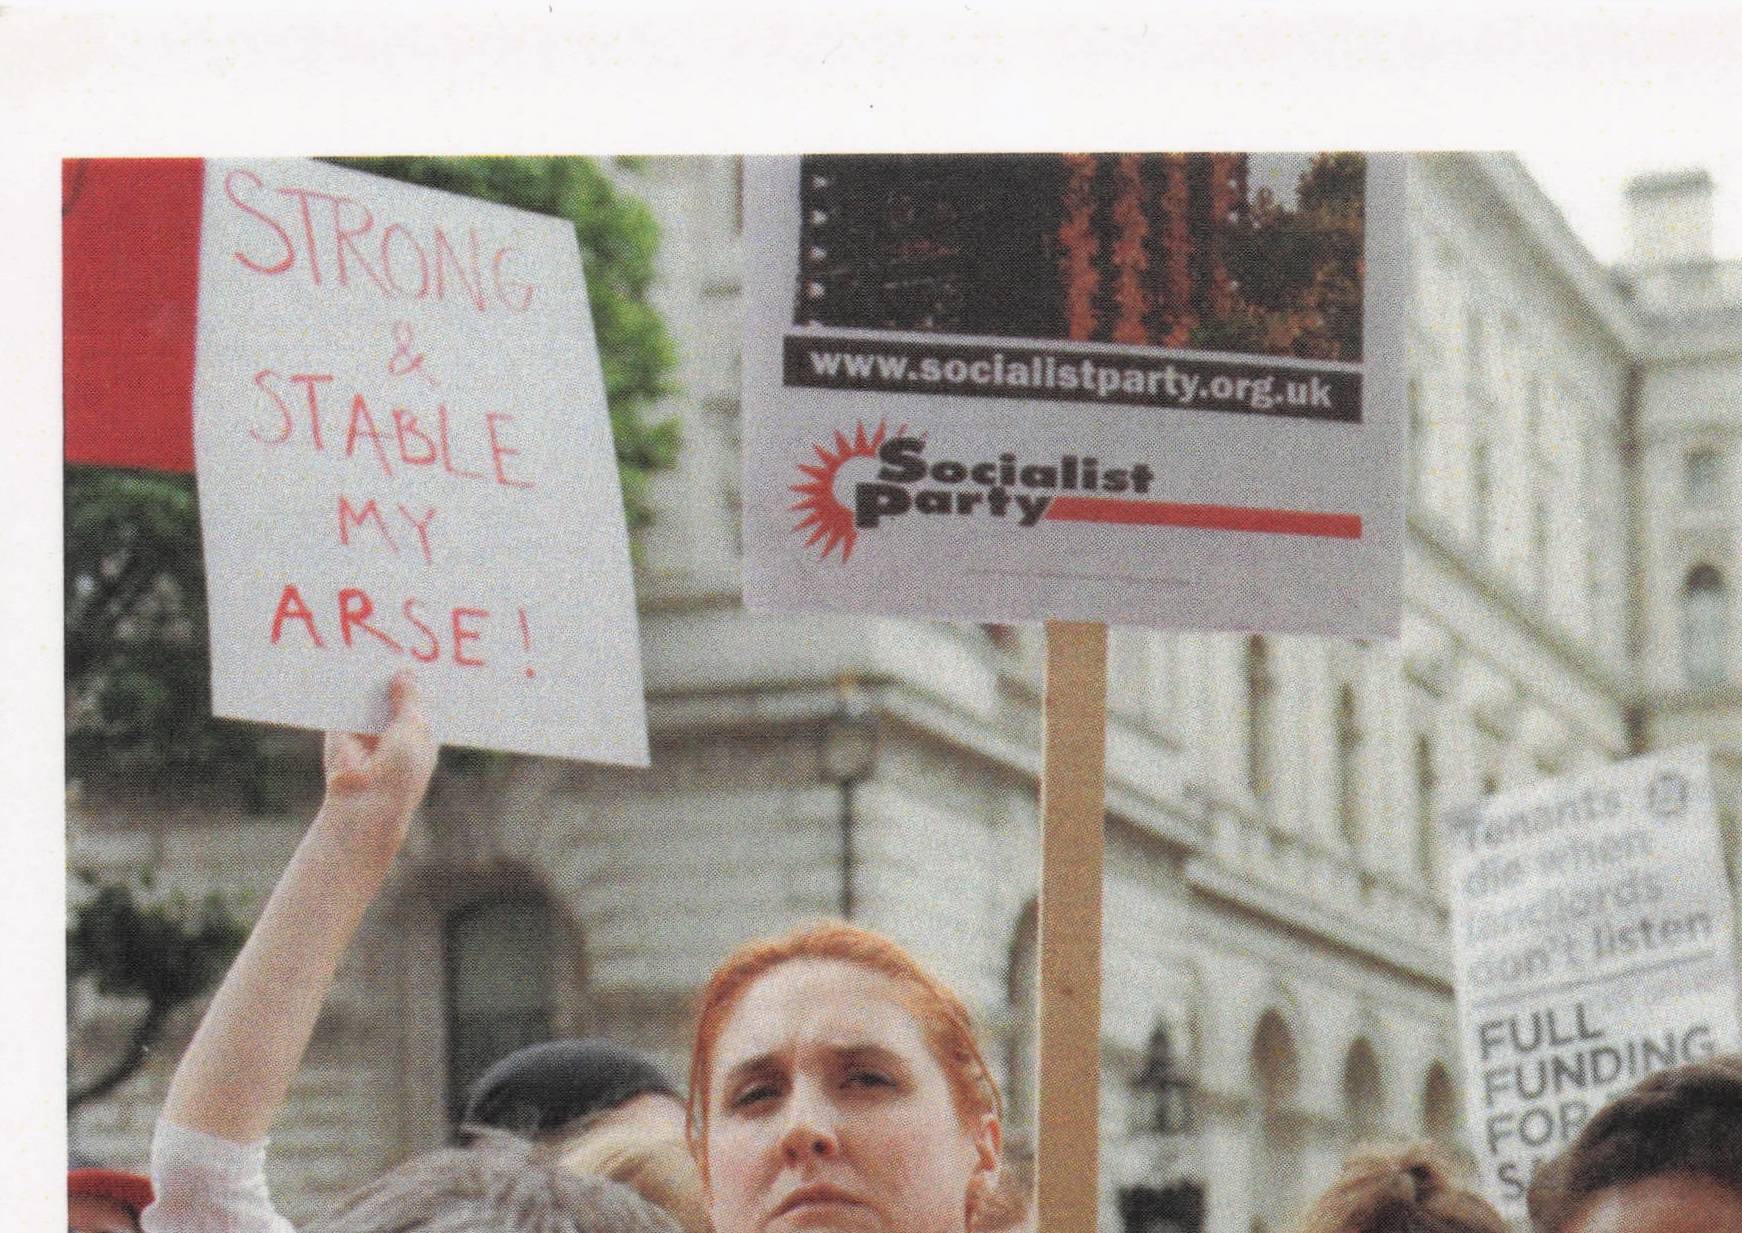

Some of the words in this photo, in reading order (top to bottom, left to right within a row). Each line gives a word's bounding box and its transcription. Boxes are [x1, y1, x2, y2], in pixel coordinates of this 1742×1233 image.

[225, 168, 536, 313] STRONG
[389, 321, 438, 388] &
[808, 347, 1332, 409] www.socialistparty.org.uk
[248, 369, 536, 490] STABLE
[878, 435, 1155, 495] Socialist
[337, 493, 438, 565] MY
[270, 584, 540, 681] ARSE!
[1459, 788, 1623, 852] Tenants
[1466, 852, 1525, 901] die
[1537, 828, 1654, 876] when
[1466, 869, 1665, 948] landlords
[1470, 930, 1581, 987] don't
[1592, 907, 1715, 961] listen
[1476, 1002, 1605, 1062] FULL
[1483, 1023, 1718, 1110] FUNDING
